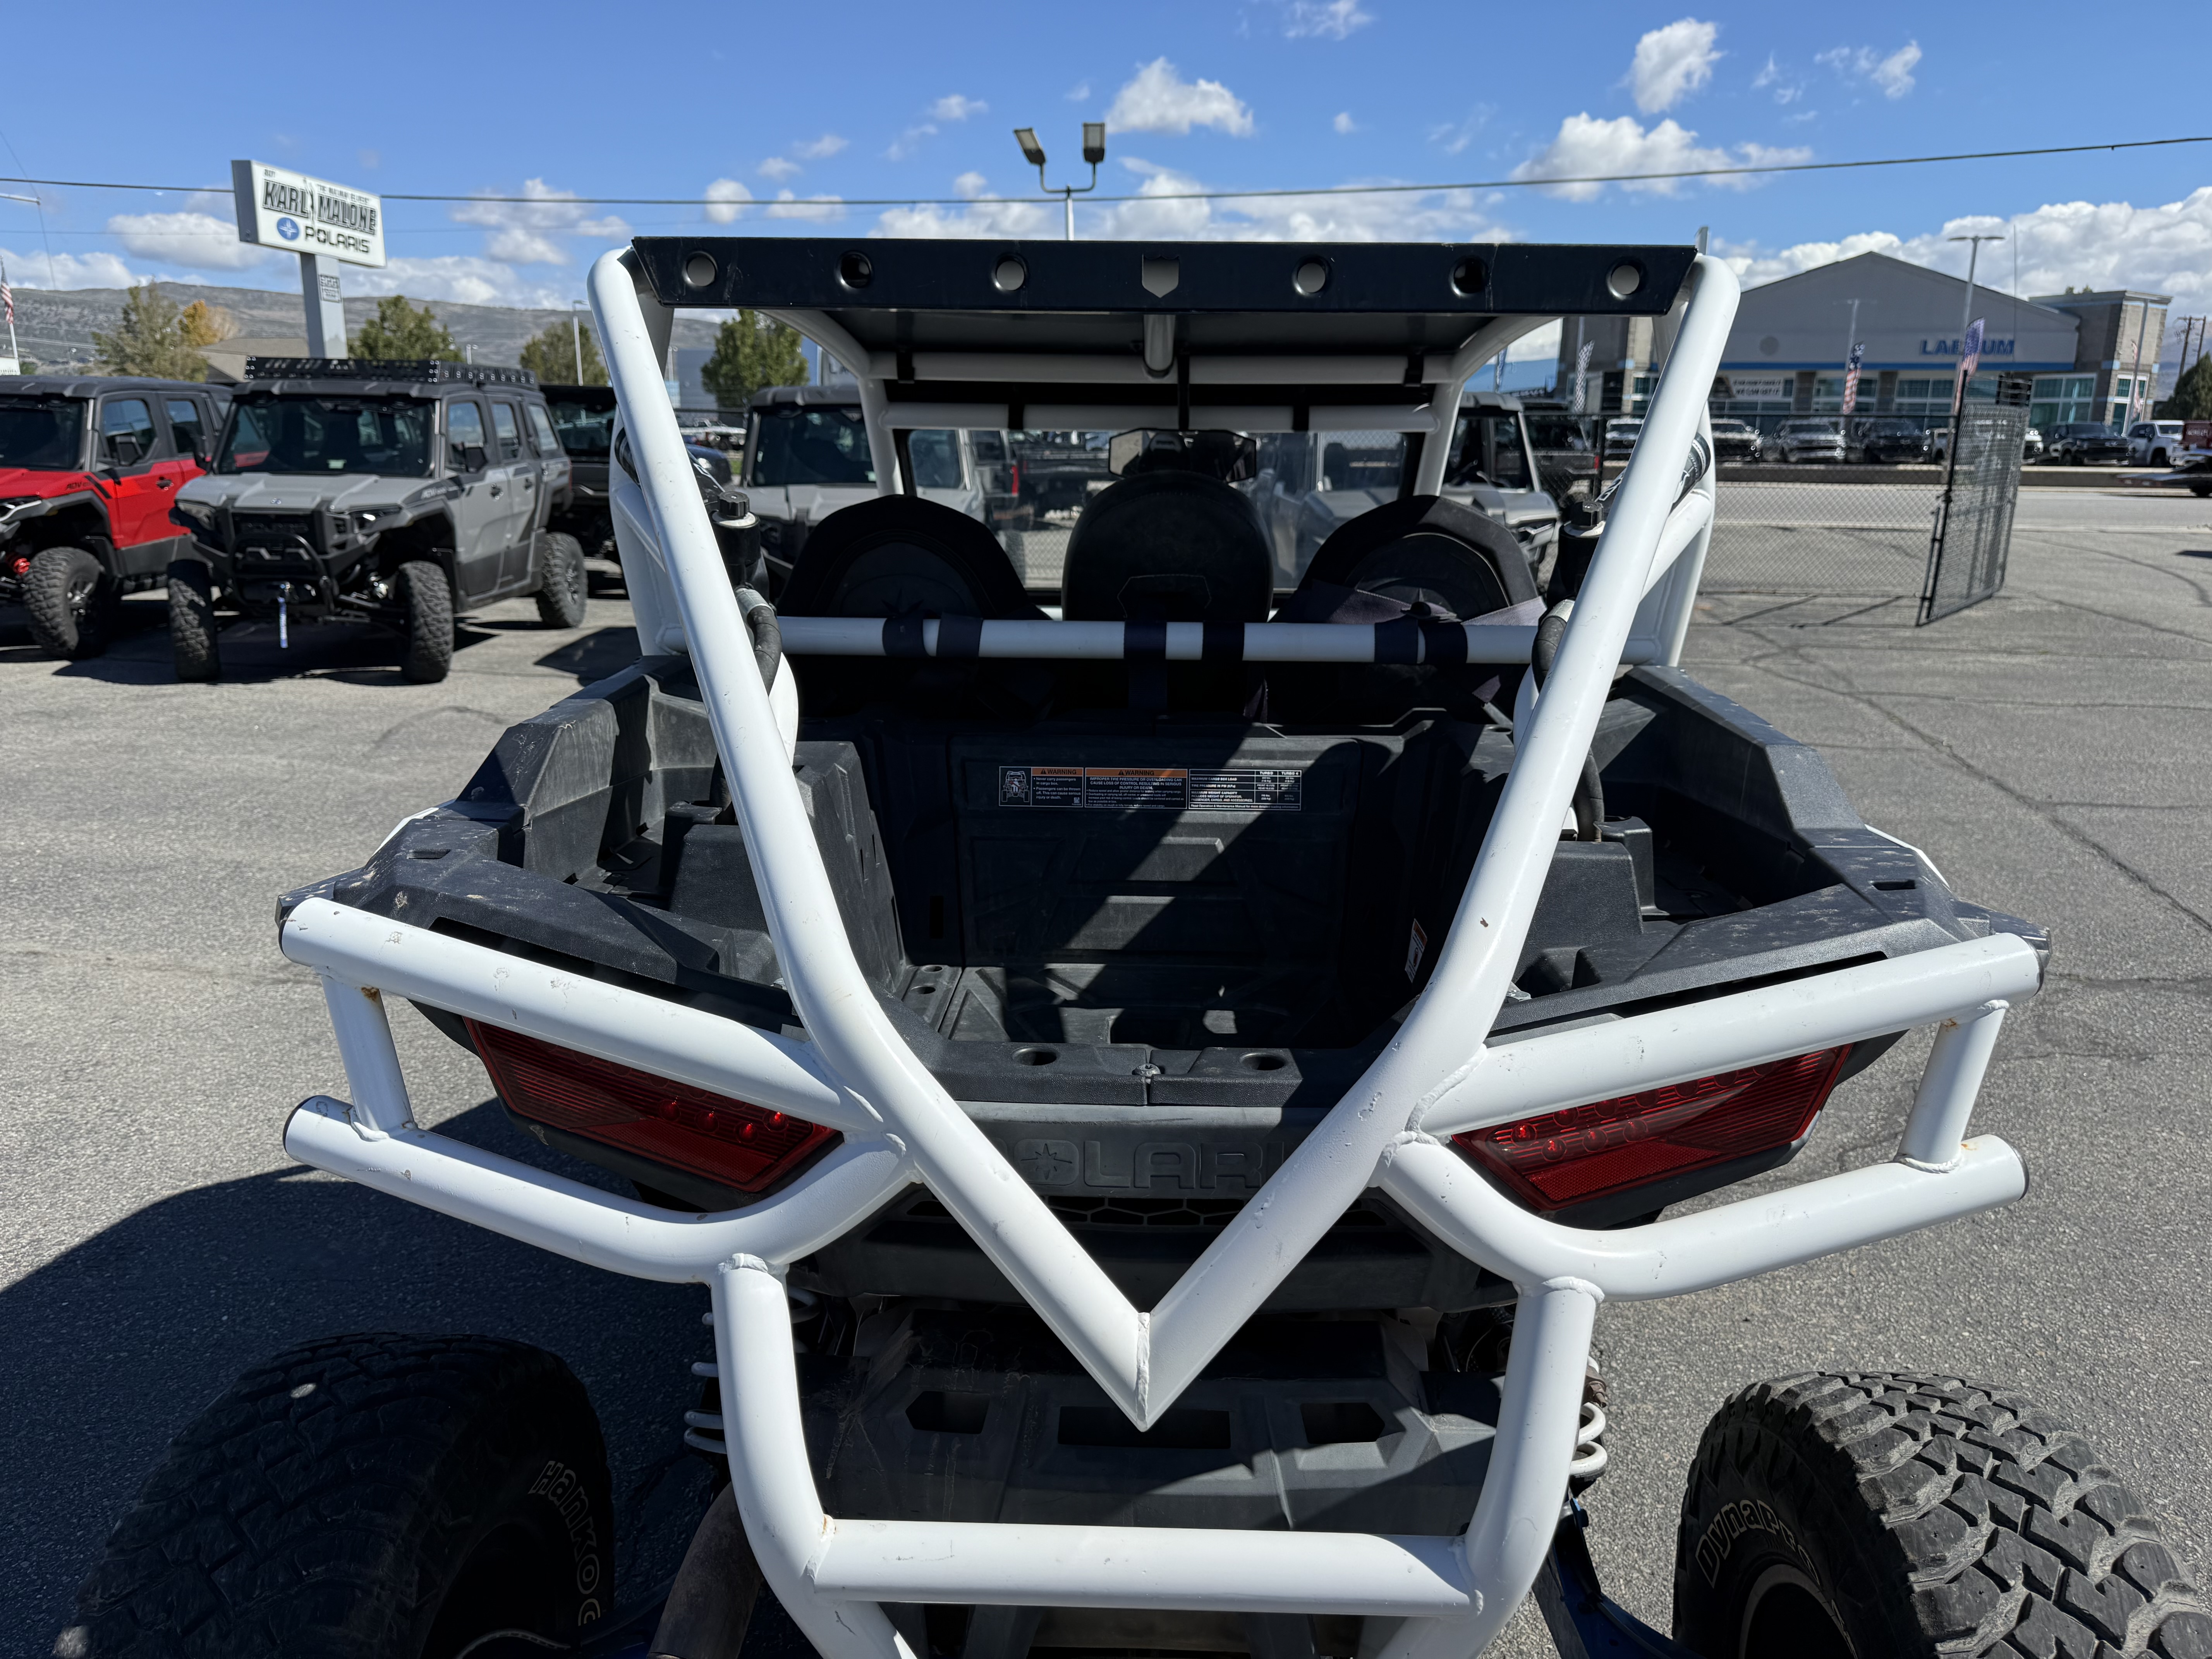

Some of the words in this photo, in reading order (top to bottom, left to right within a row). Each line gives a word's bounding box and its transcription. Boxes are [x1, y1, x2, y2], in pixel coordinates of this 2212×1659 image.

[262, 179, 310, 218] KARL
[316, 194, 378, 235] MALONE
[305, 225, 371, 254] POLARIS
[1920, 338, 2015, 356] LAUM
[993, 1138, 1286, 1189] OLARI
[527, 1460, 601, 1626] Hankoo
